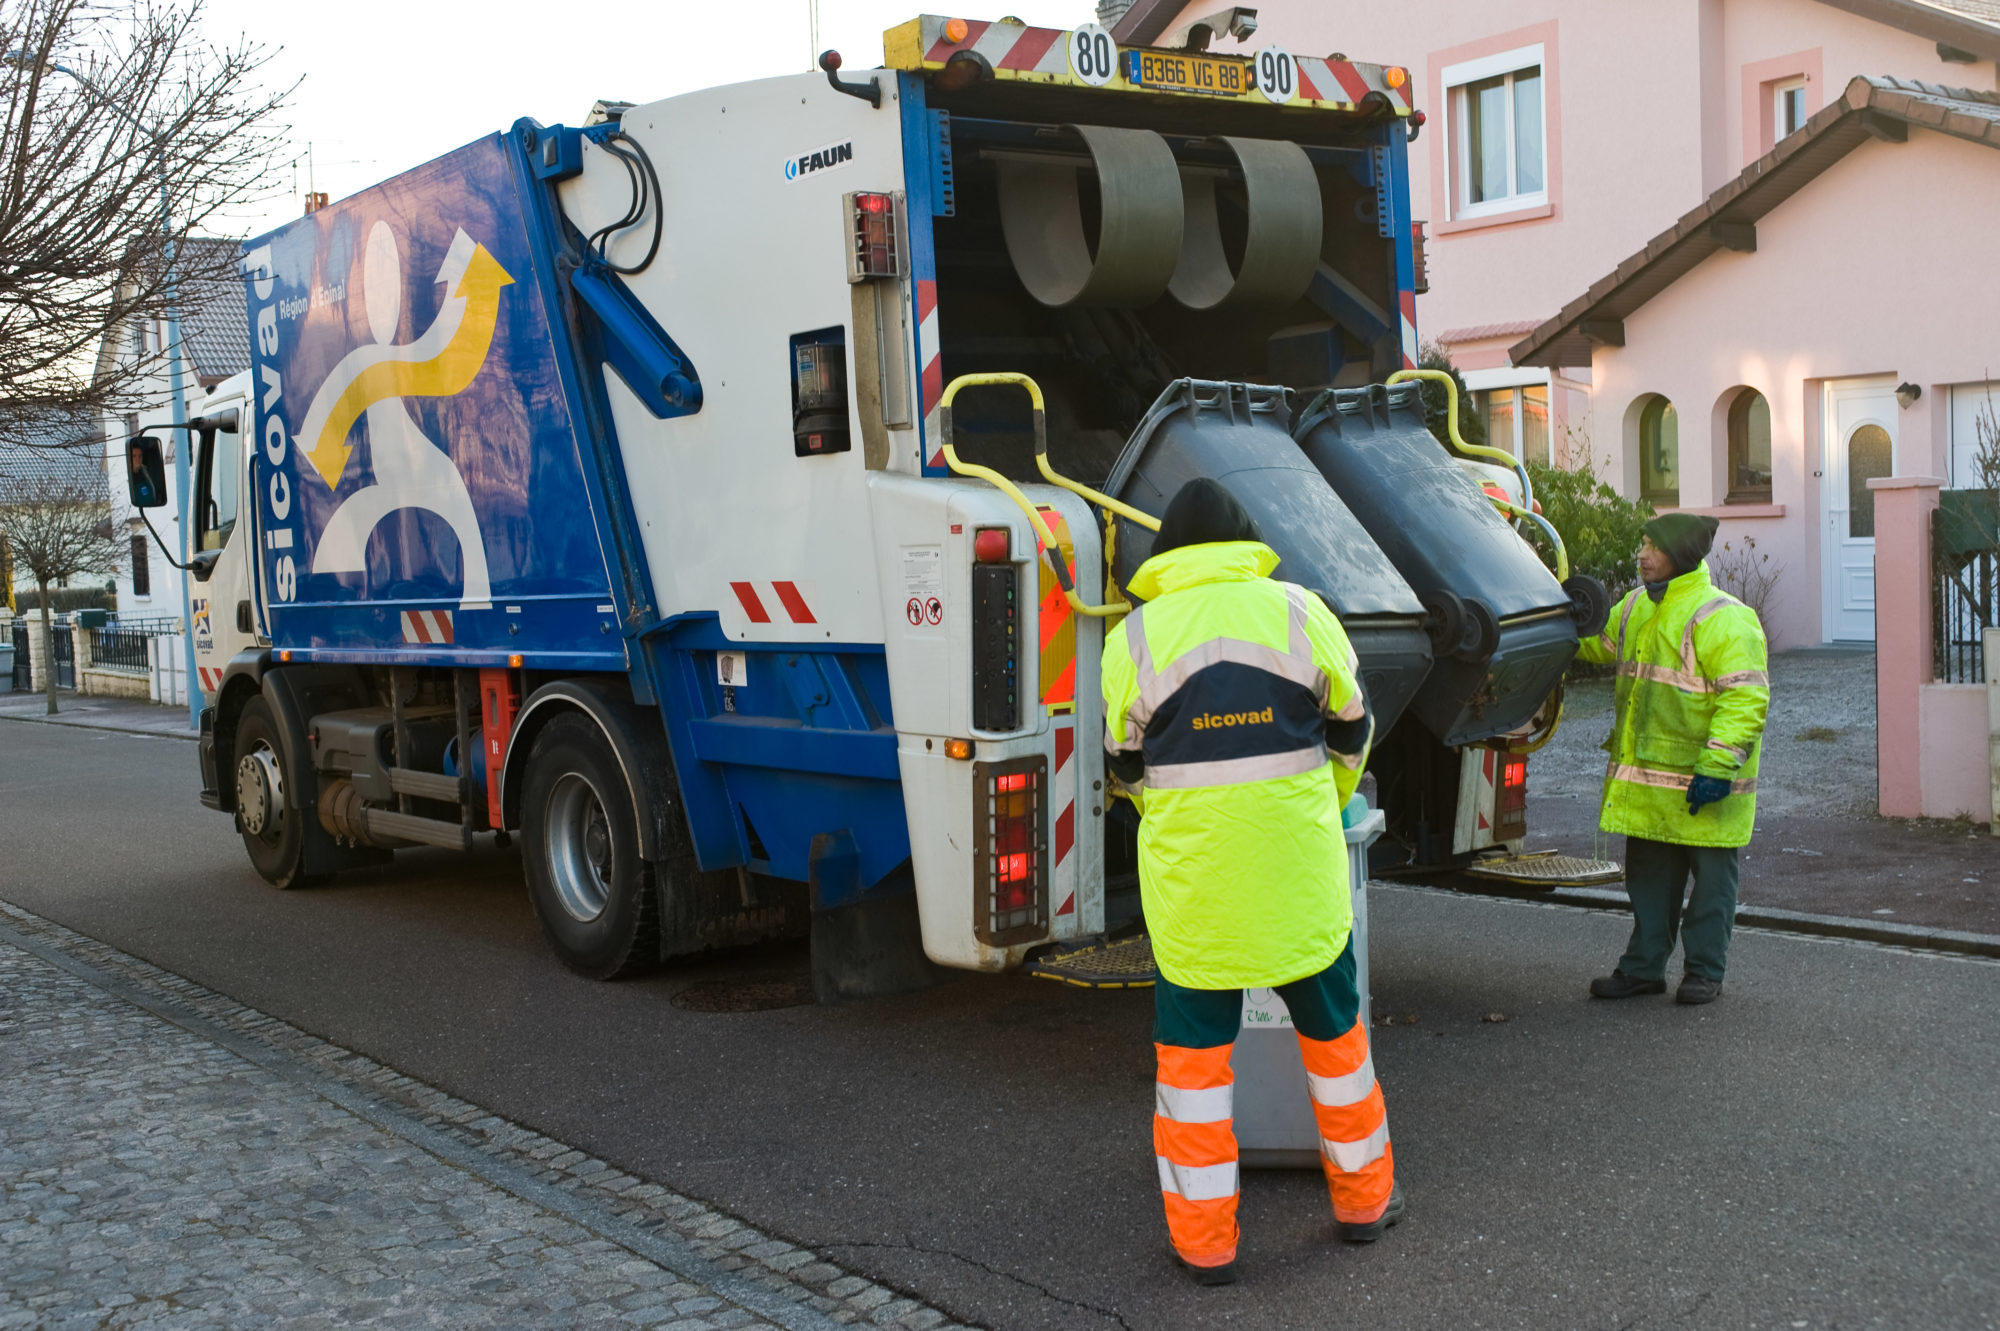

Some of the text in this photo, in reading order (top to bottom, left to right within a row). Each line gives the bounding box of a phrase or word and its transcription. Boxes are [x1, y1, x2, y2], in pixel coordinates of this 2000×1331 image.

[1077, 31, 1110, 78] 80
[1143, 57, 1239, 89] 8366 VG 88
[1261, 52, 1291, 95] 90
[799, 142, 852, 175] FAUN
[279, 295, 308, 320] Région
[245, 243, 297, 602] sicovad
[1191, 706, 1274, 730] sicovad
